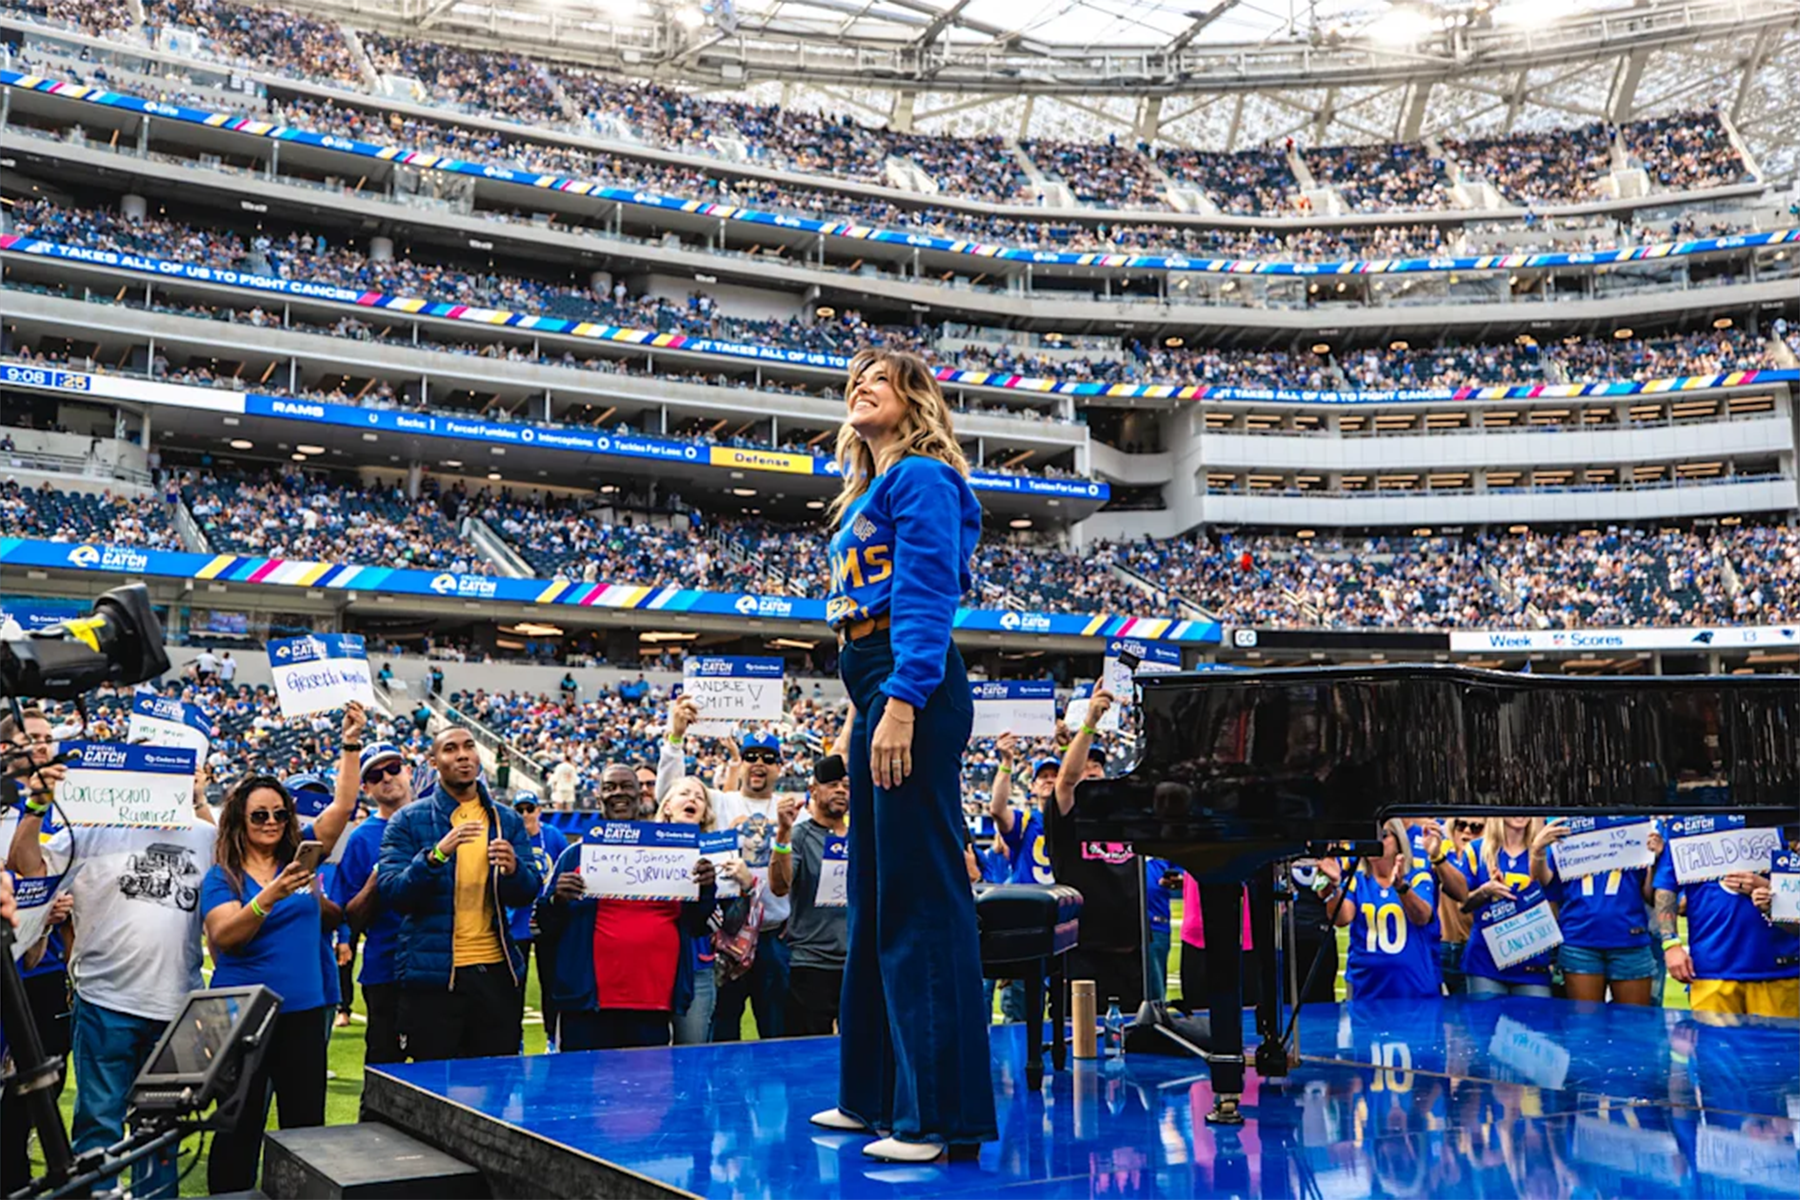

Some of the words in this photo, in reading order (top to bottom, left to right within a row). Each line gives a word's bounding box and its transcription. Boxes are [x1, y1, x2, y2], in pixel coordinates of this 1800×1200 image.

[58, 245, 118, 264] TAKES
[121, 255, 156, 270] ALL
[159, 262, 183, 273] OF
[186, 266, 210, 279] US
[213, 270, 237, 283] TO
[239, 274, 287, 290] FIGHT
[290, 282, 357, 300] CANCER
[714, 342, 758, 356] TAKES
[760, 348, 786, 360] ALL
[788, 351, 806, 361] OF
[808, 354, 826, 364] US
[827, 356, 845, 367] TO
[7, 368, 46, 384] 9:08
[1234, 390, 1274, 400] TAKES
[1276, 391, 1299, 400] ALL
[1340, 392, 1357, 402] TO
[272, 402, 325, 417] RAMS
[735, 453, 790, 467] Defense
[102, 553, 148, 567] CATCH
[458, 579, 497, 593] CATCH
[759, 600, 792, 612] CATCH
[1238, 632, 1255, 644] CC
[1489, 634, 1532, 648] Week
[1570, 633, 1624, 647] Scores
[1742, 630, 1757, 642] 13
[292, 641, 327, 657] CATCH
[701, 662, 733, 672] CATCH
[689, 680, 745, 693] ANDRE
[694, 694, 744, 710] SMITH
[84, 751, 127, 764] CATCH
[119, 806, 177, 822] Ramirez
[1684, 818, 1714, 832] CATCH
[604, 828, 640, 840] CATCH
[592, 850, 628, 865] Larry
[635, 849, 686, 864] Johnson
[625, 864, 693, 886] SURVIVOR
[1361, 902, 1407, 954] 10
[1498, 931, 1535, 958] CANCER
